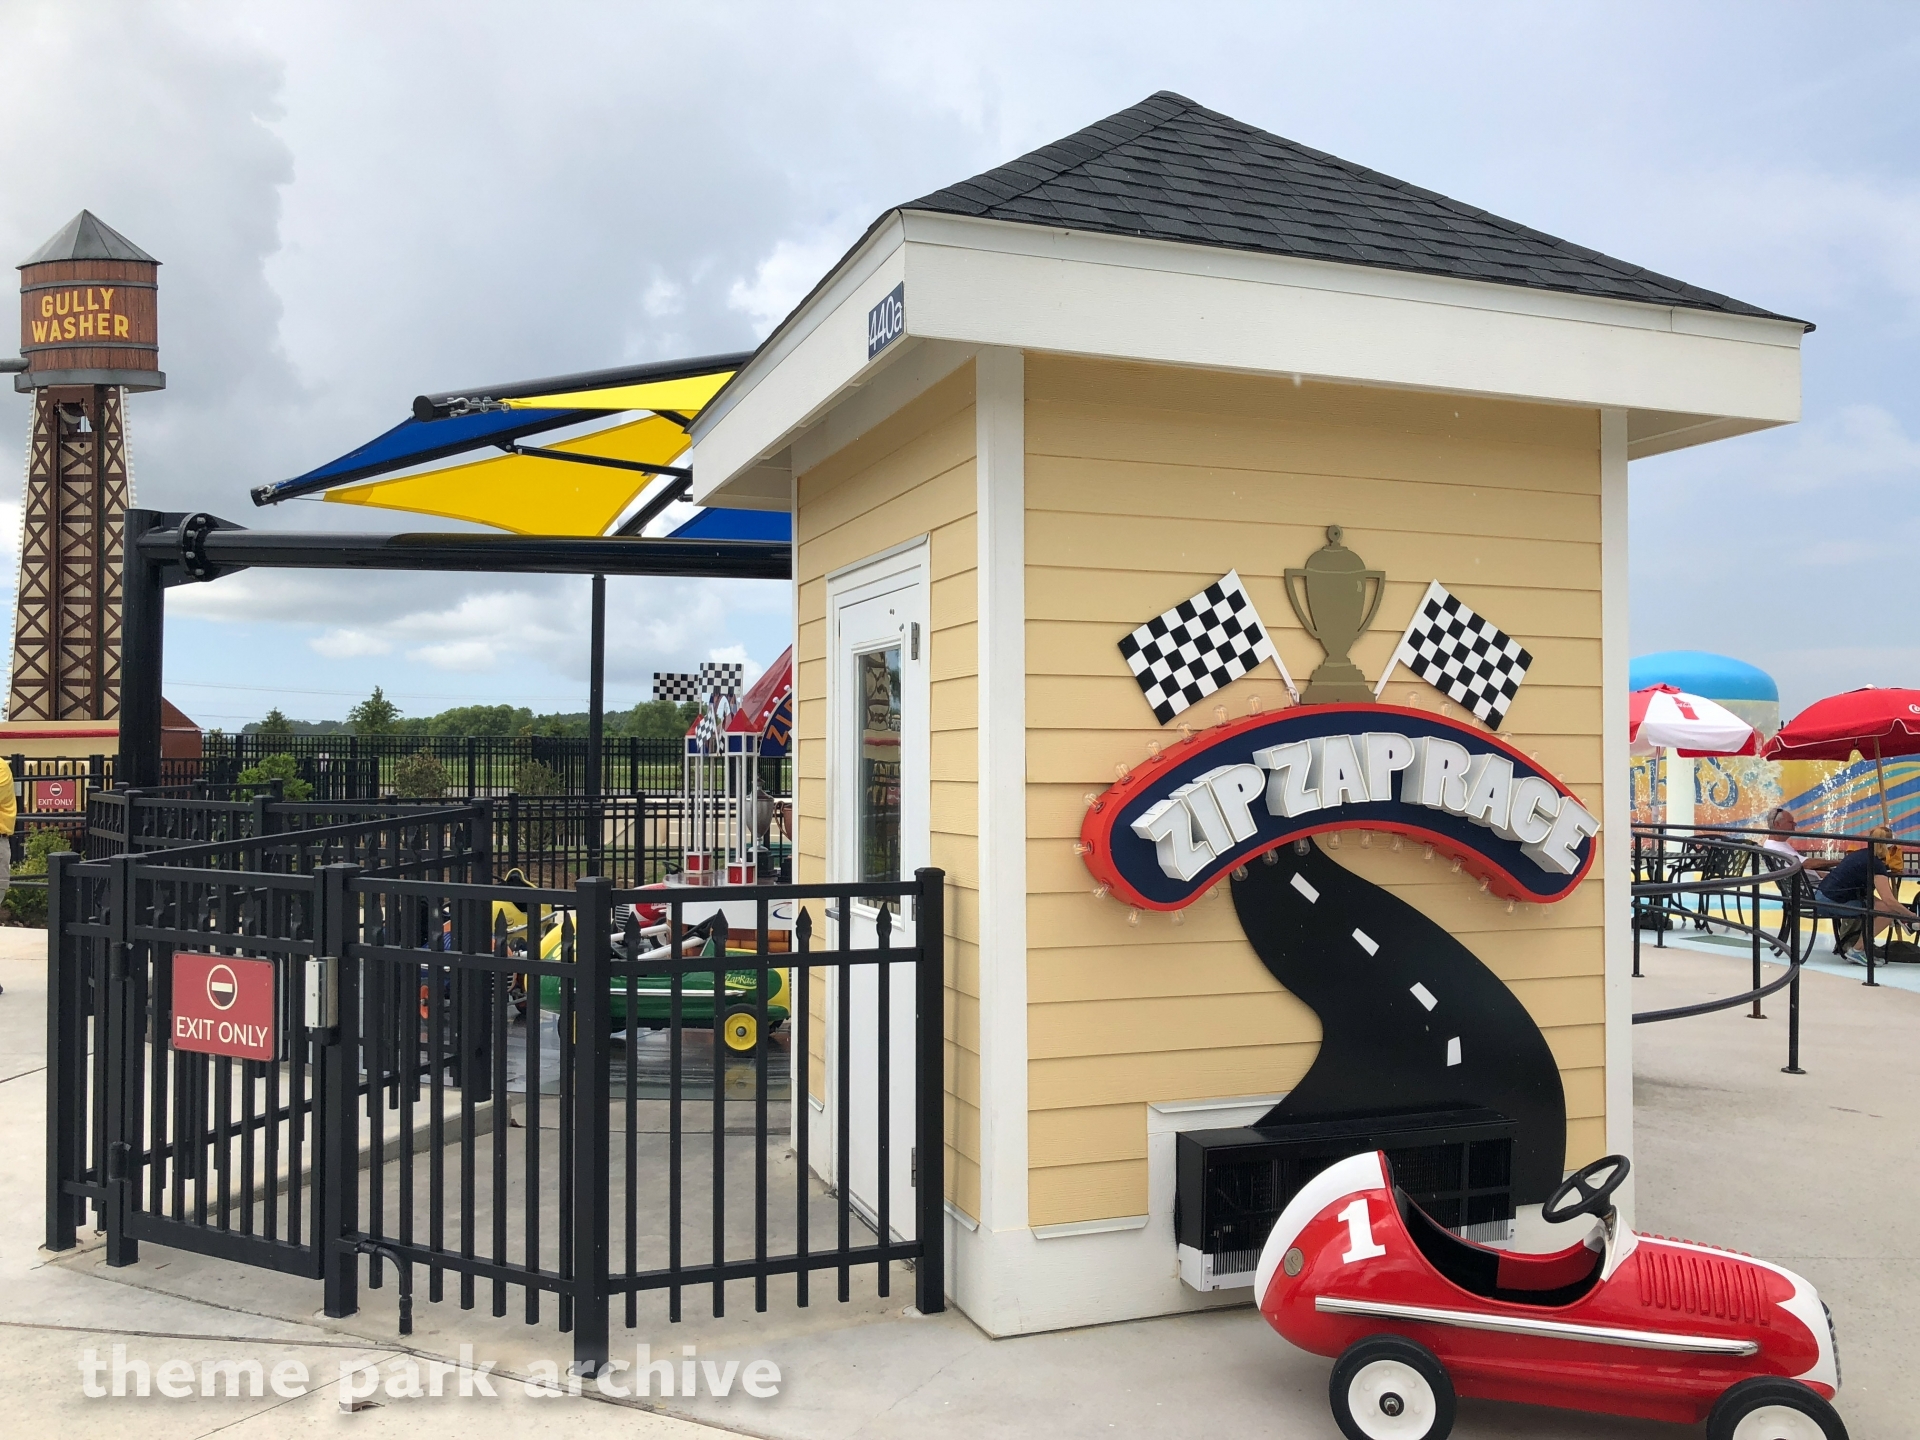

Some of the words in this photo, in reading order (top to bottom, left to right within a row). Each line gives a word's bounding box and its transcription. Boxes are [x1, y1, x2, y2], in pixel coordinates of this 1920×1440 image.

[41, 287, 115, 318] GULLY
[31, 313, 129, 343] WASHER
[869, 295, 903, 351] 440a
[37, 798, 54, 806] EXIT
[54, 798, 74, 806] ONLY
[1130, 763, 1267, 882] ZIP
[1252, 731, 1416, 818] ZAP
[1400, 735, 1601, 875] RACE
[176, 1015, 215, 1041] EXIT
[218, 1021, 269, 1048] ONLY
[1337, 1198, 1387, 1264] 1
